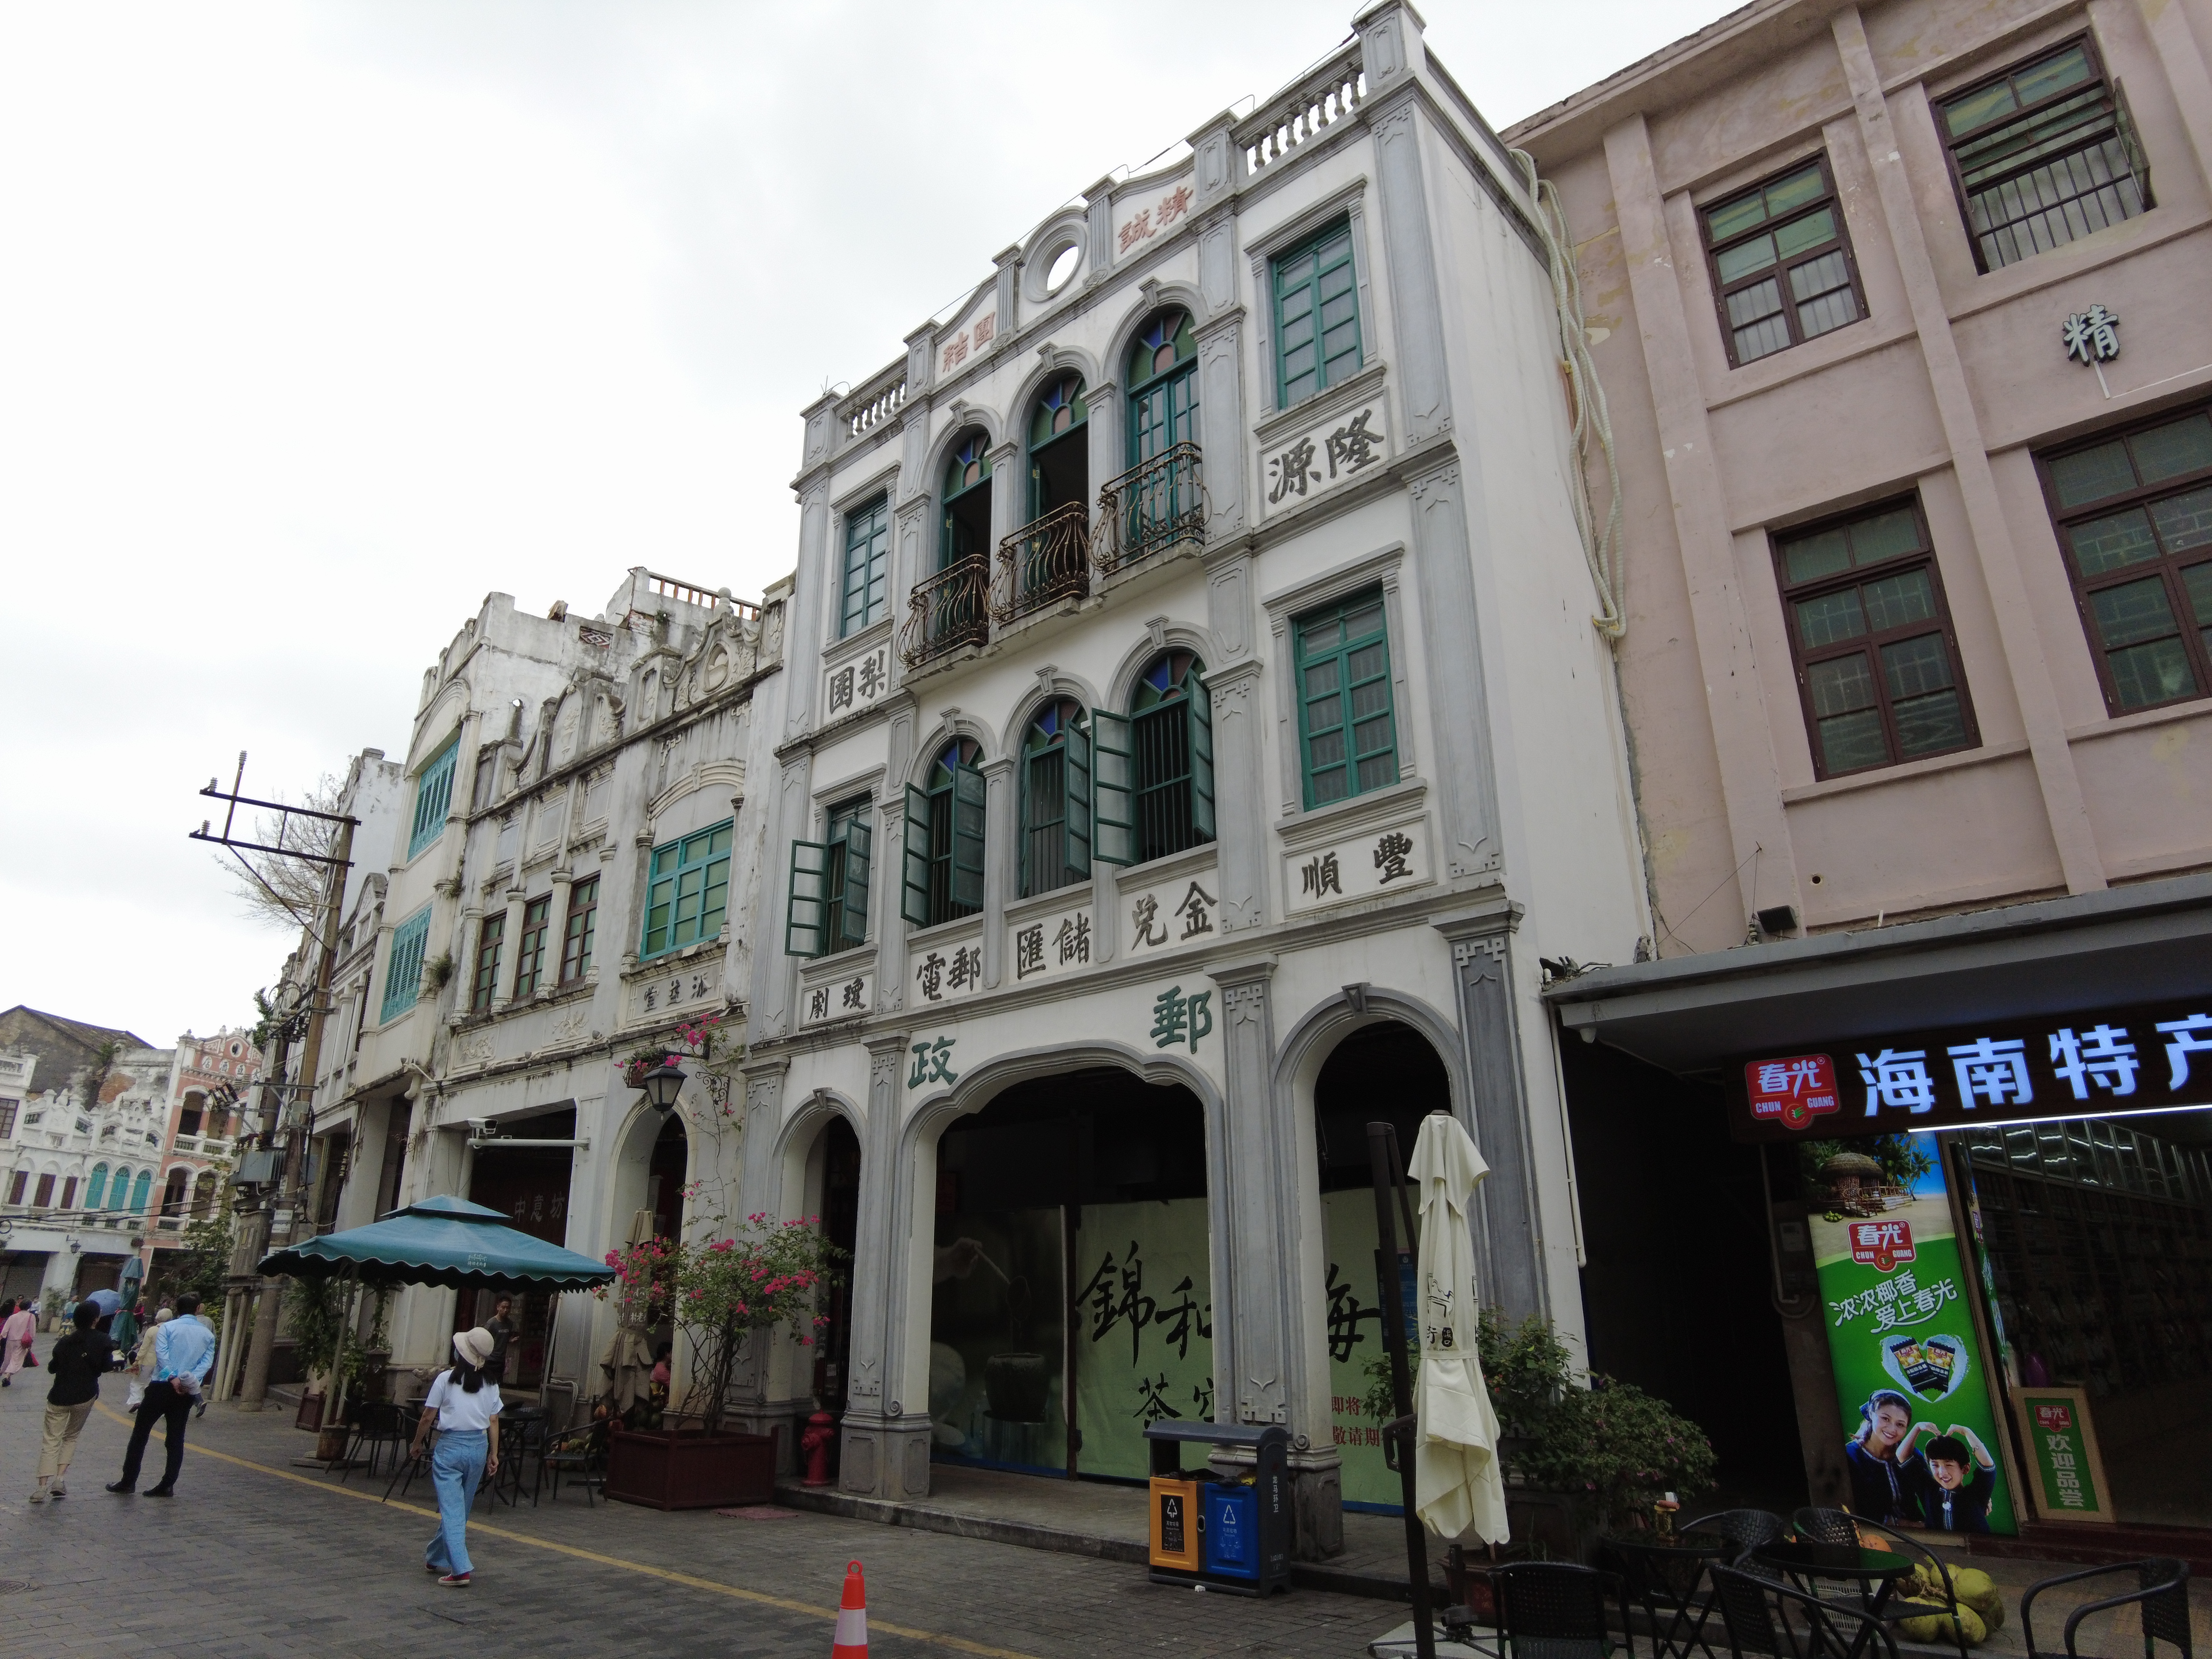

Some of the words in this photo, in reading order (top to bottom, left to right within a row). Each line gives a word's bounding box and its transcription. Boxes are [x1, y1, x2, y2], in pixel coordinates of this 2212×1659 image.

[2063, 304, 2119, 366] 精
[1757, 1059, 1822, 1099] 春光
[1854, 1013, 2212, 1118] 海南特产
[1755, 1101, 1782, 1113] CHUN
[1807, 1095, 1835, 1108] GUANG
[1857, 1223, 1903, 1251] 春光
[1856, 1250, 1875, 1260] CHUN
[1892, 1249, 1912, 1258] GUANG
[1828, 1268, 1917, 1327] 浓浓椰香
[1870, 1277, 1959, 1334] 爱上春光
[1331, 1395, 1361, 1416] 即将
[2040, 1407, 2065, 1420] 春光
[1332, 1425, 1380, 1447] 敬请期
[2046, 1434, 2084, 1507] 欢迎品尝
